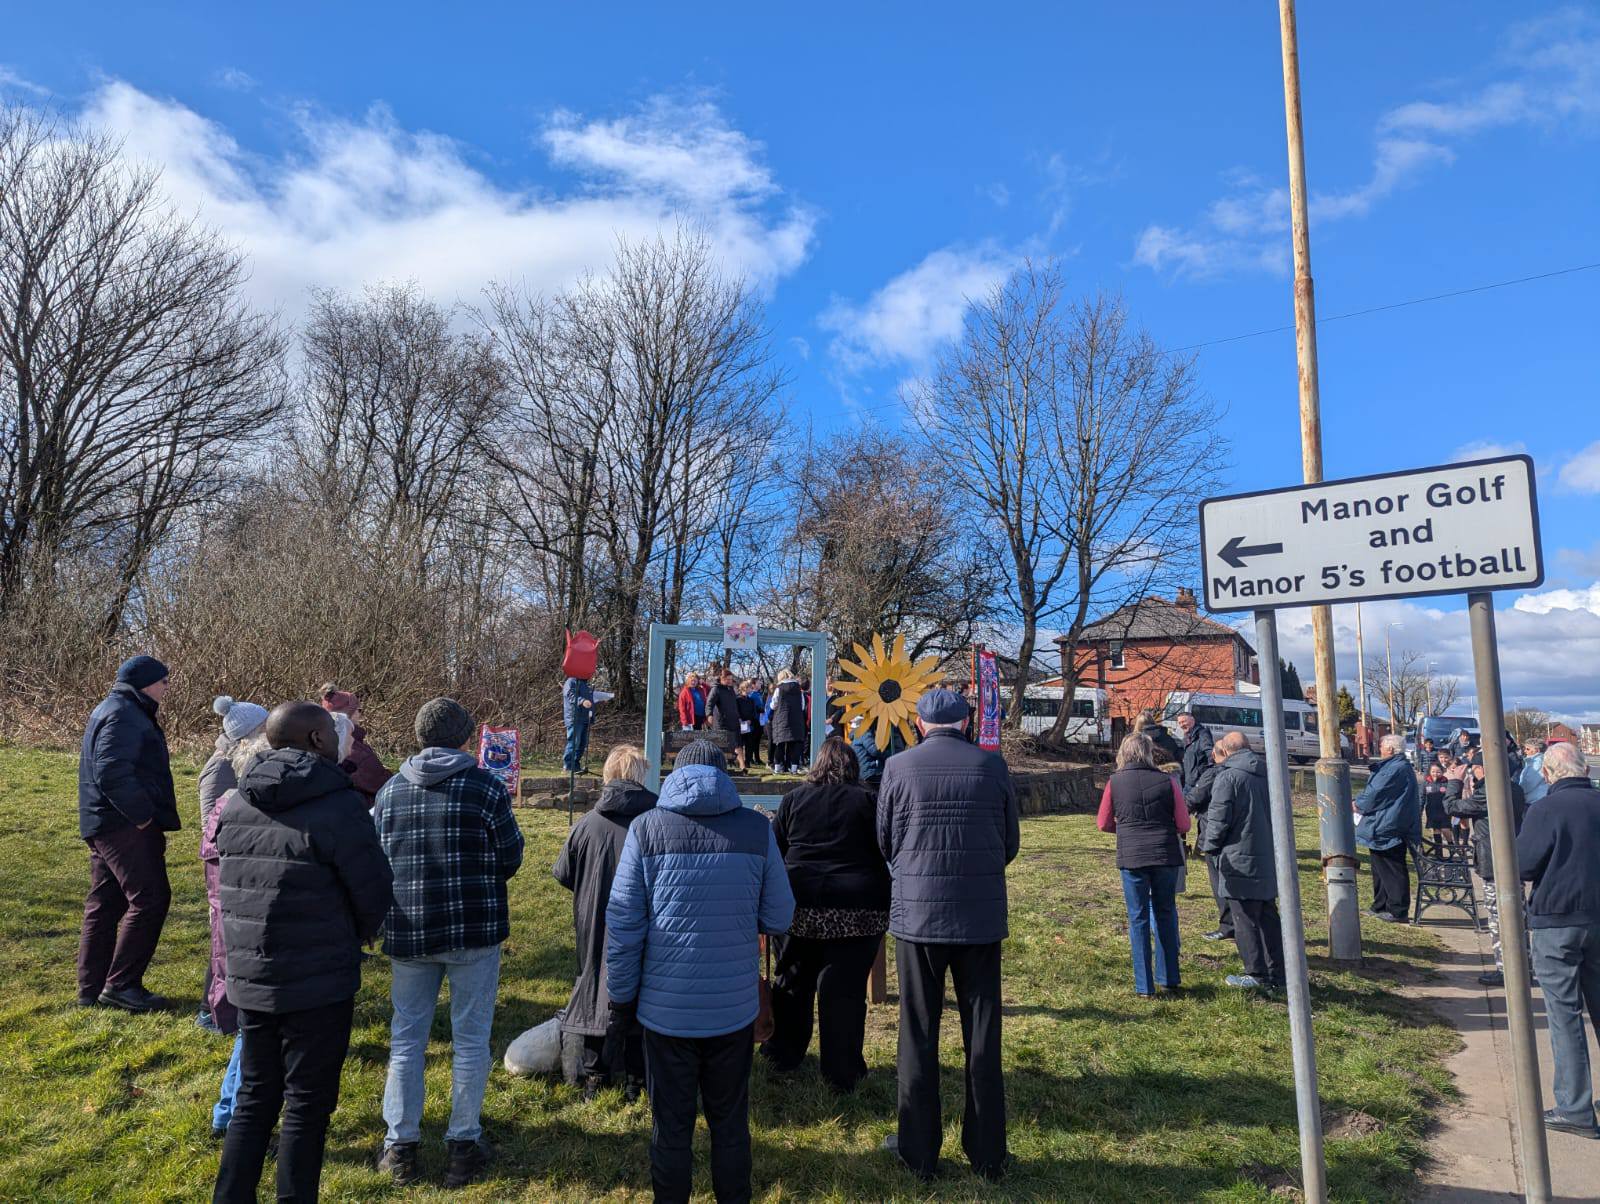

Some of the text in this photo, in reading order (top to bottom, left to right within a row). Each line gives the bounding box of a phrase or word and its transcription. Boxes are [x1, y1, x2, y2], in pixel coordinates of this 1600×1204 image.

[1301, 475, 1505, 524] Manor Golf
[1369, 517, 1434, 549] and
[1213, 546, 1527, 600] Manor 5's football
